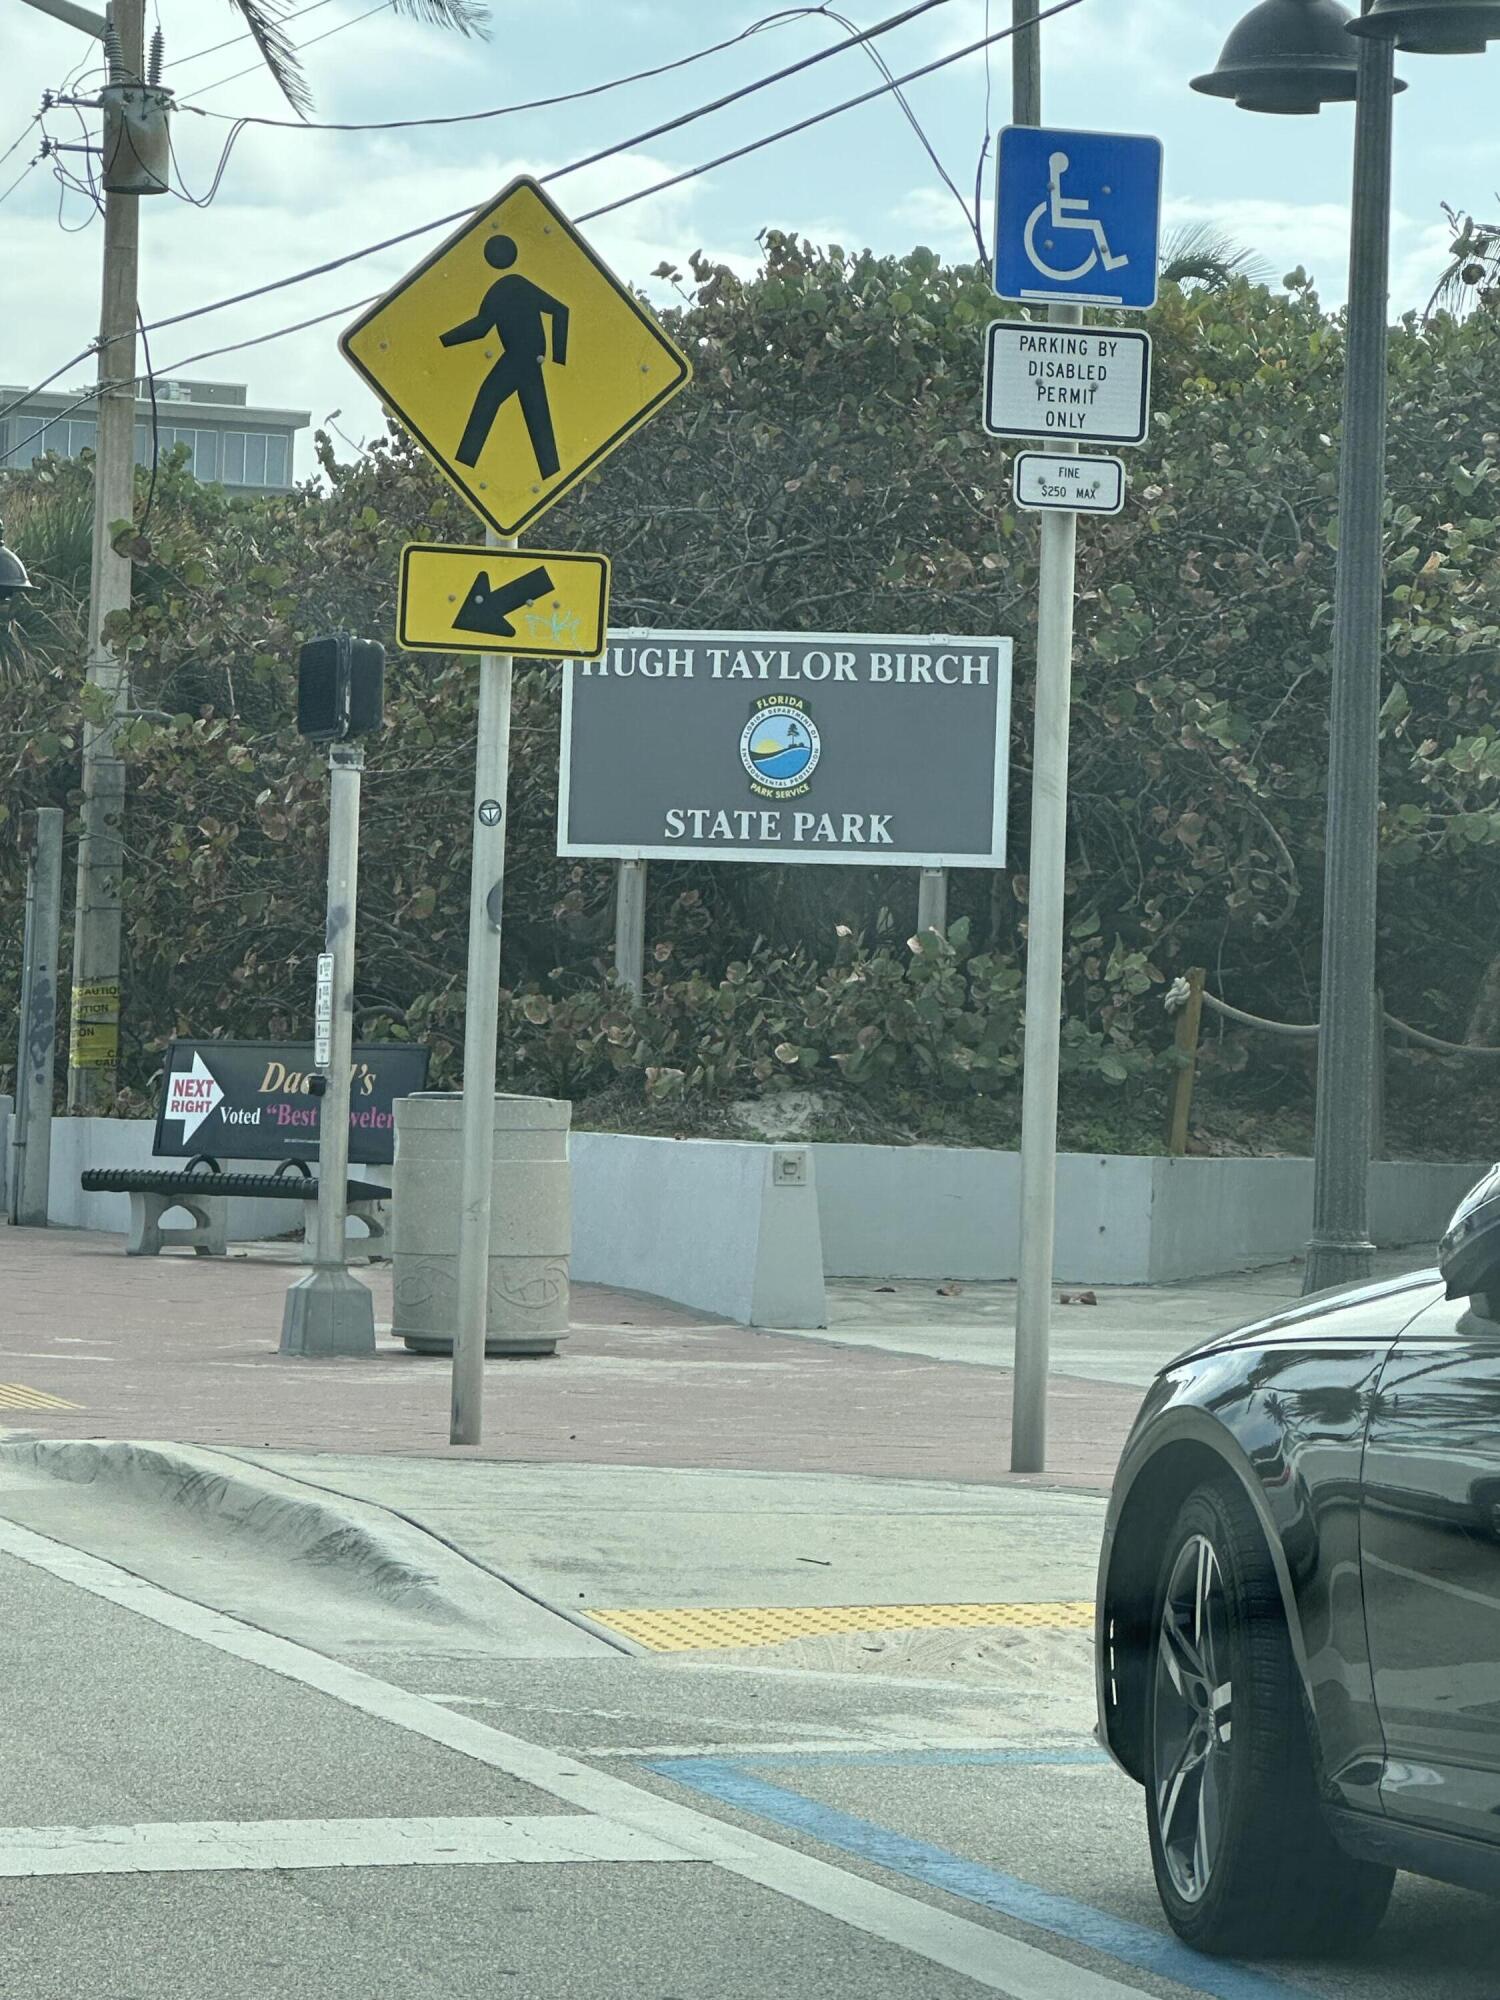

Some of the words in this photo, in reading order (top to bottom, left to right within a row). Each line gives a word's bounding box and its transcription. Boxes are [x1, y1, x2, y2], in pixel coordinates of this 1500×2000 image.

[1019, 335, 1088, 356] PARKING
[1098, 341, 1117, 357] BY
[1028, 360, 1107, 381] DISABLED
[1037, 386, 1096, 405] PERMIT
[1045, 410, 1086, 429] ONLY
[1058, 466, 1080, 479] FINE
[1041, 485, 1067, 498] $250
[1076, 487, 1096, 500] MAX
[707, 649, 859, 682] TAYLOR
[870, 653, 991, 686] BIRCH
[756, 695, 804, 709] FLORIDA
[743, 713, 766, 739] FLORIDA
[768, 707, 813, 728] DEPARTMENT
[810, 729, 818, 739] OF
[741, 748, 787, 787] ENVIRONMENTAL
[790, 748, 819, 785] PROTECTION
[750, 783, 773, 798] PARK
[775, 782, 811, 799] SERVICE
[664, 808, 782, 841] STATE
[794, 812, 895, 844] PARK
[173, 1079, 214, 1098] NEXT
[170, 1100, 212, 1113] RIGHT
[219, 1106, 261, 1125] Voted
